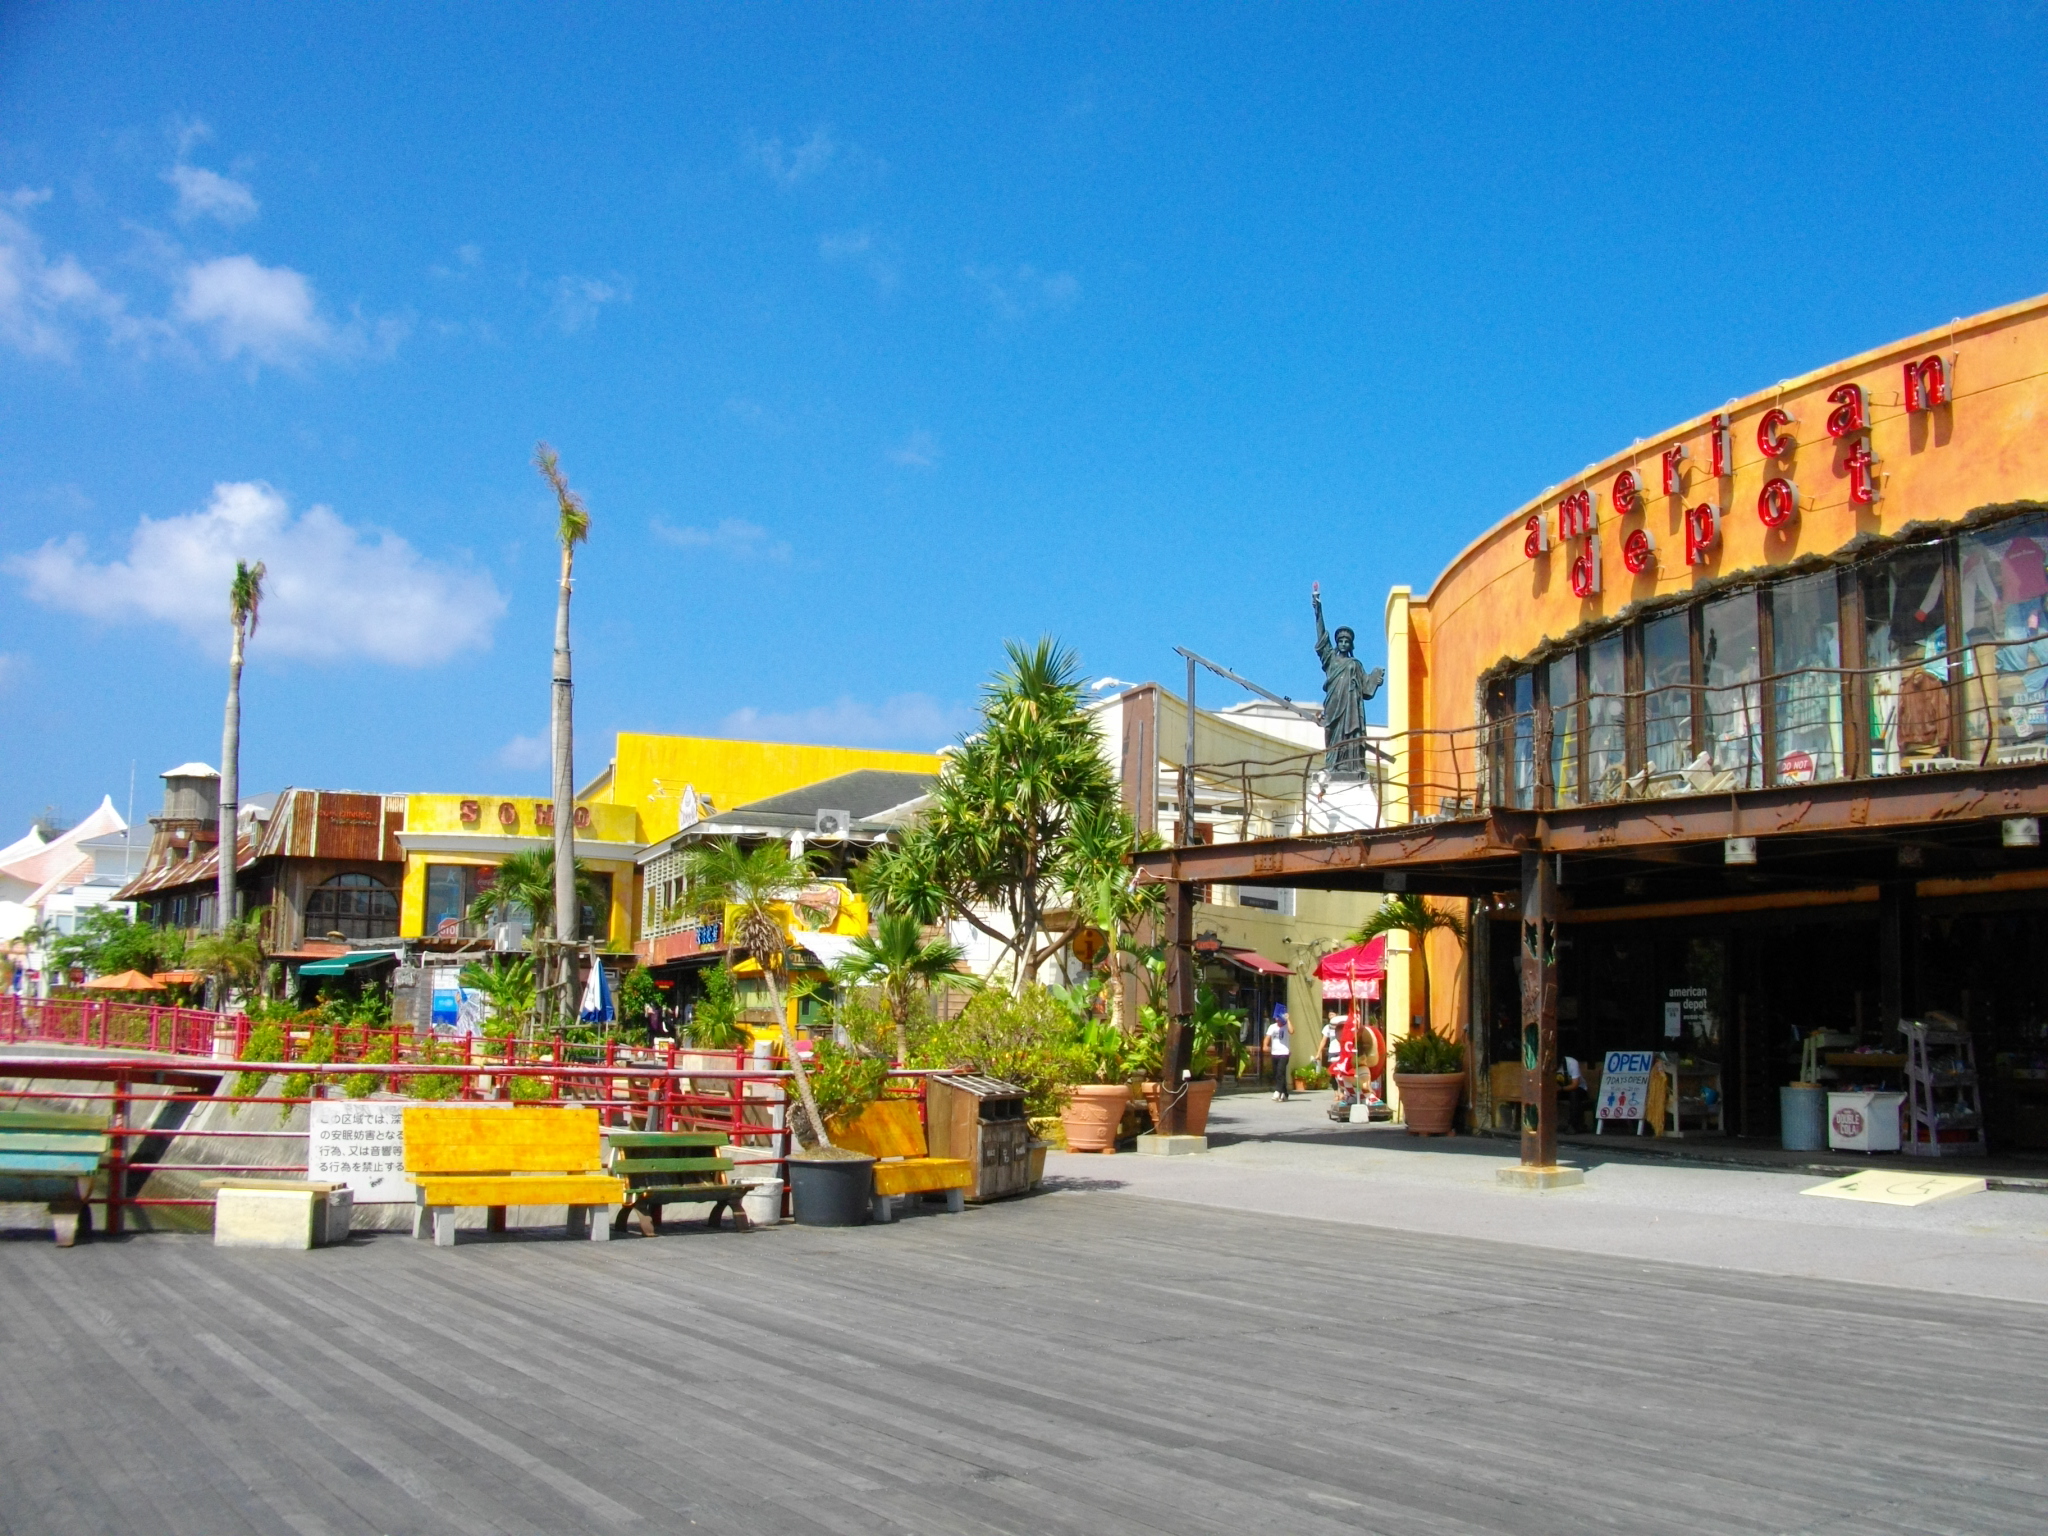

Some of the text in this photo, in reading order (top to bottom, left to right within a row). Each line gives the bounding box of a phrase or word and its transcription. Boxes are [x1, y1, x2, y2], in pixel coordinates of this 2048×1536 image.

[1525, 354, 1951, 559] american
[1572, 437, 1879, 598] depot
[1794, 760, 1808, 770] NOT
[460, 800, 590, 828] SOHO
[440, 925, 458, 935] STO
[1669, 986, 1707, 997] american
[1682, 998, 1707, 1011] depot
[1607, 1052, 1651, 1073] OPEN
[1836, 1114, 1860, 1125] DOUBLE
[1840, 1124, 1856, 1135] COLA
[319, 1161, 405, 1172] る行為を禁止する
